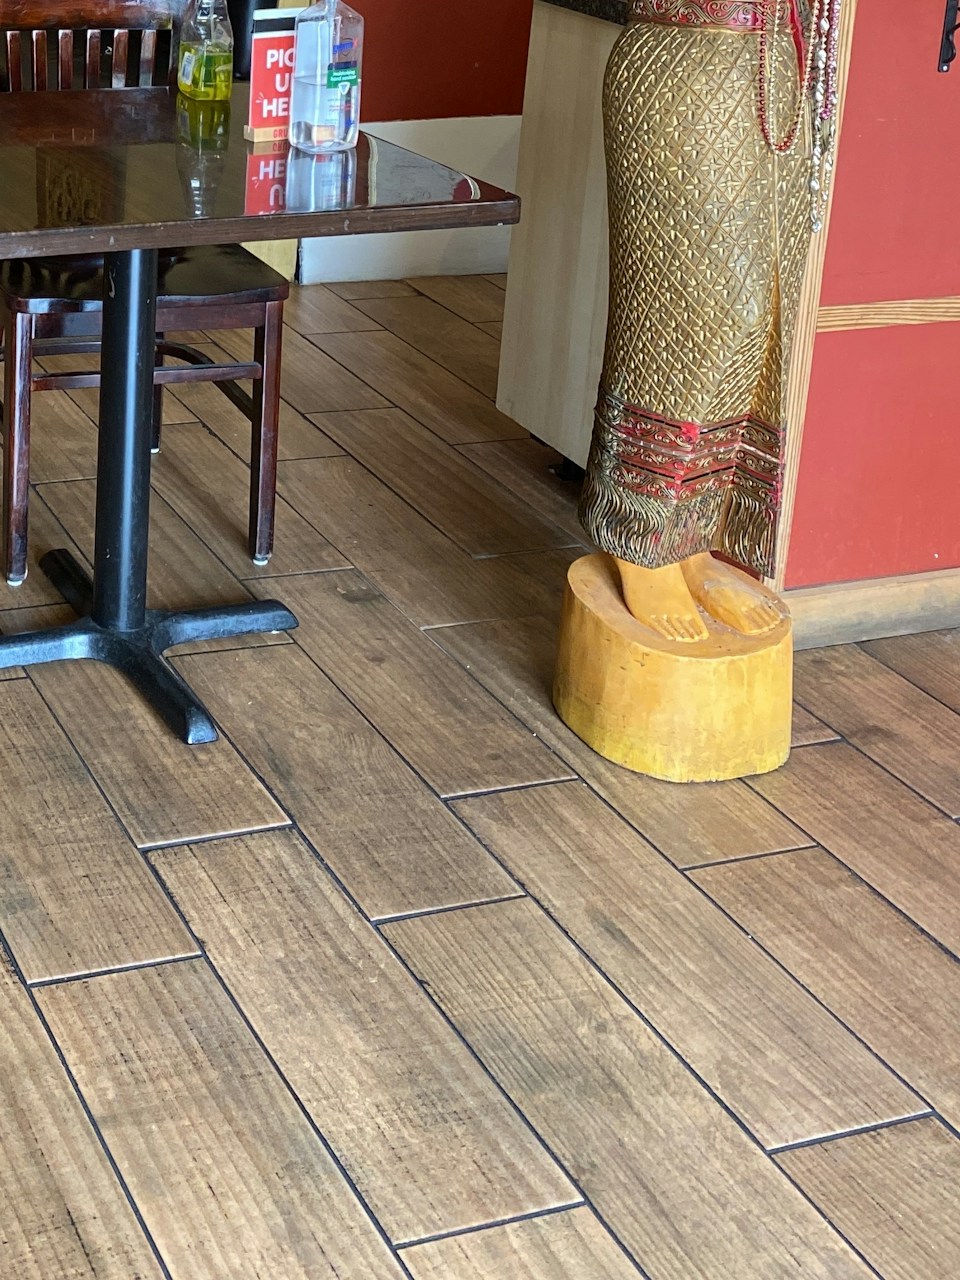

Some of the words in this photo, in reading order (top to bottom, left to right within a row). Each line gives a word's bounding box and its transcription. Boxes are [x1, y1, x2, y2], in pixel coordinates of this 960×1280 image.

[266, 47, 294, 69] PIC
[275, 73, 291, 93] U
[262, 97, 289, 118] HE
[273, 128, 288, 139] GRU
